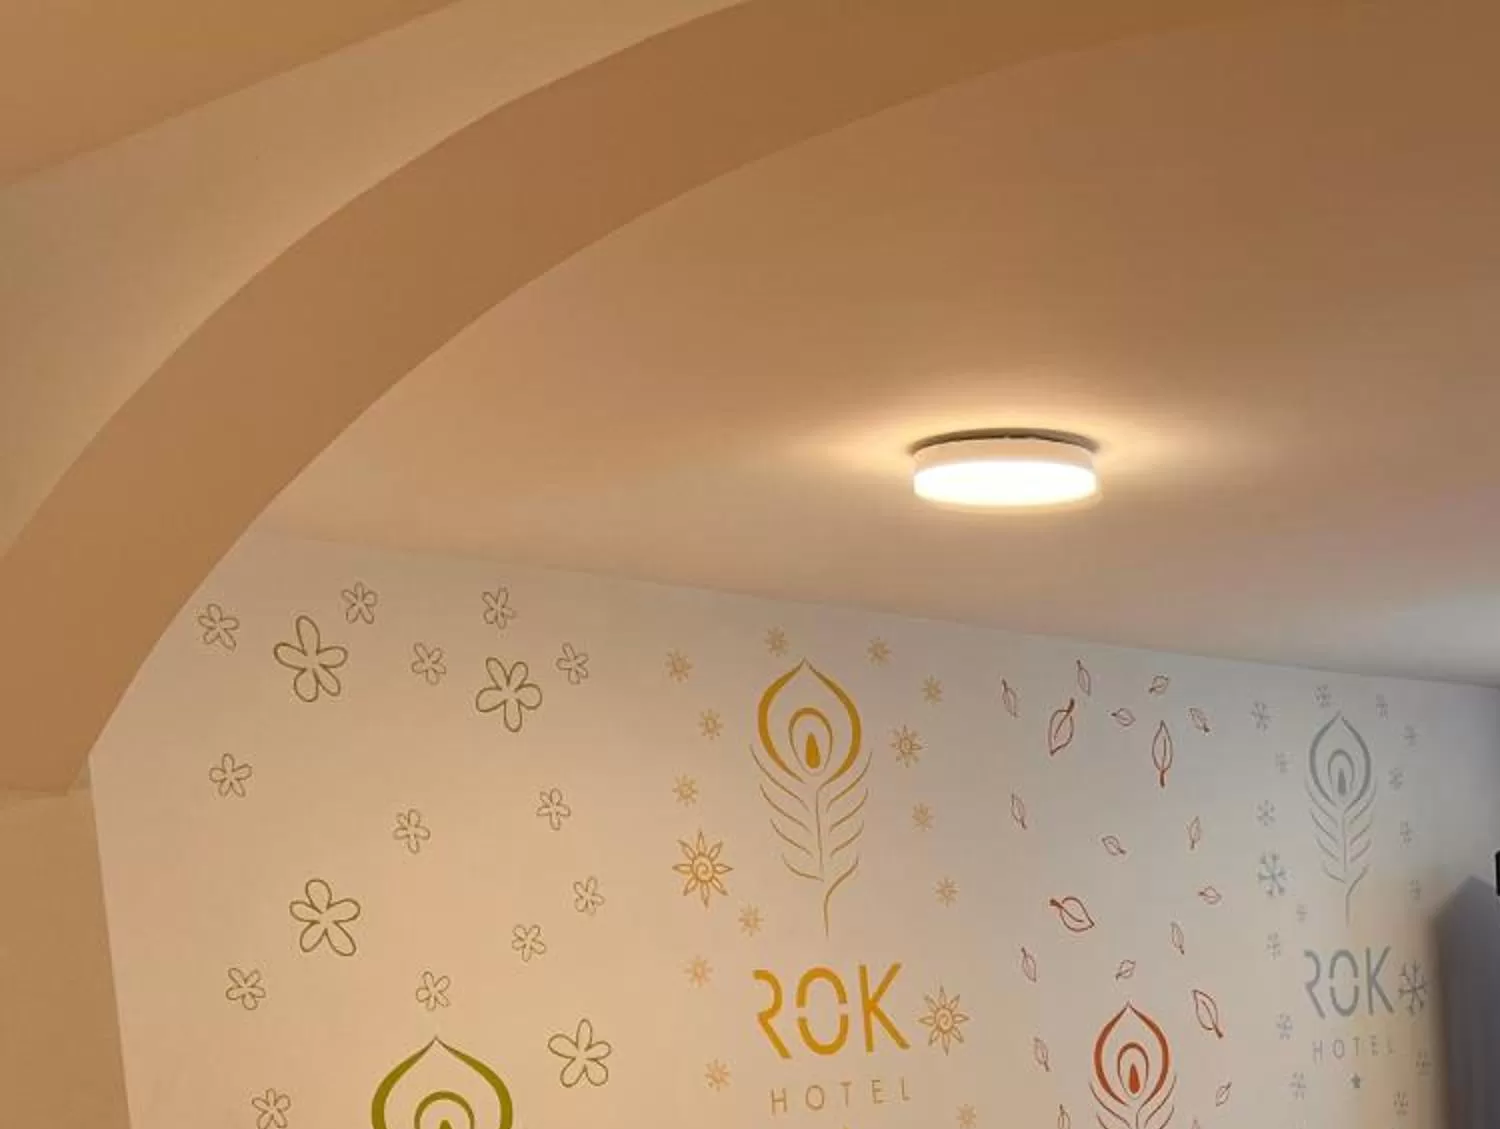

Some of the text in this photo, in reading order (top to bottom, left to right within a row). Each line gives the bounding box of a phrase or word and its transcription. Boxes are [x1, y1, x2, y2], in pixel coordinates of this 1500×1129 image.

[752, 962, 911, 1059] ROK
[1304, 945, 1395, 1020] ROK
[1312, 1035, 1396, 1064] HOTEL
[769, 1076, 911, 1116] HOTEL
